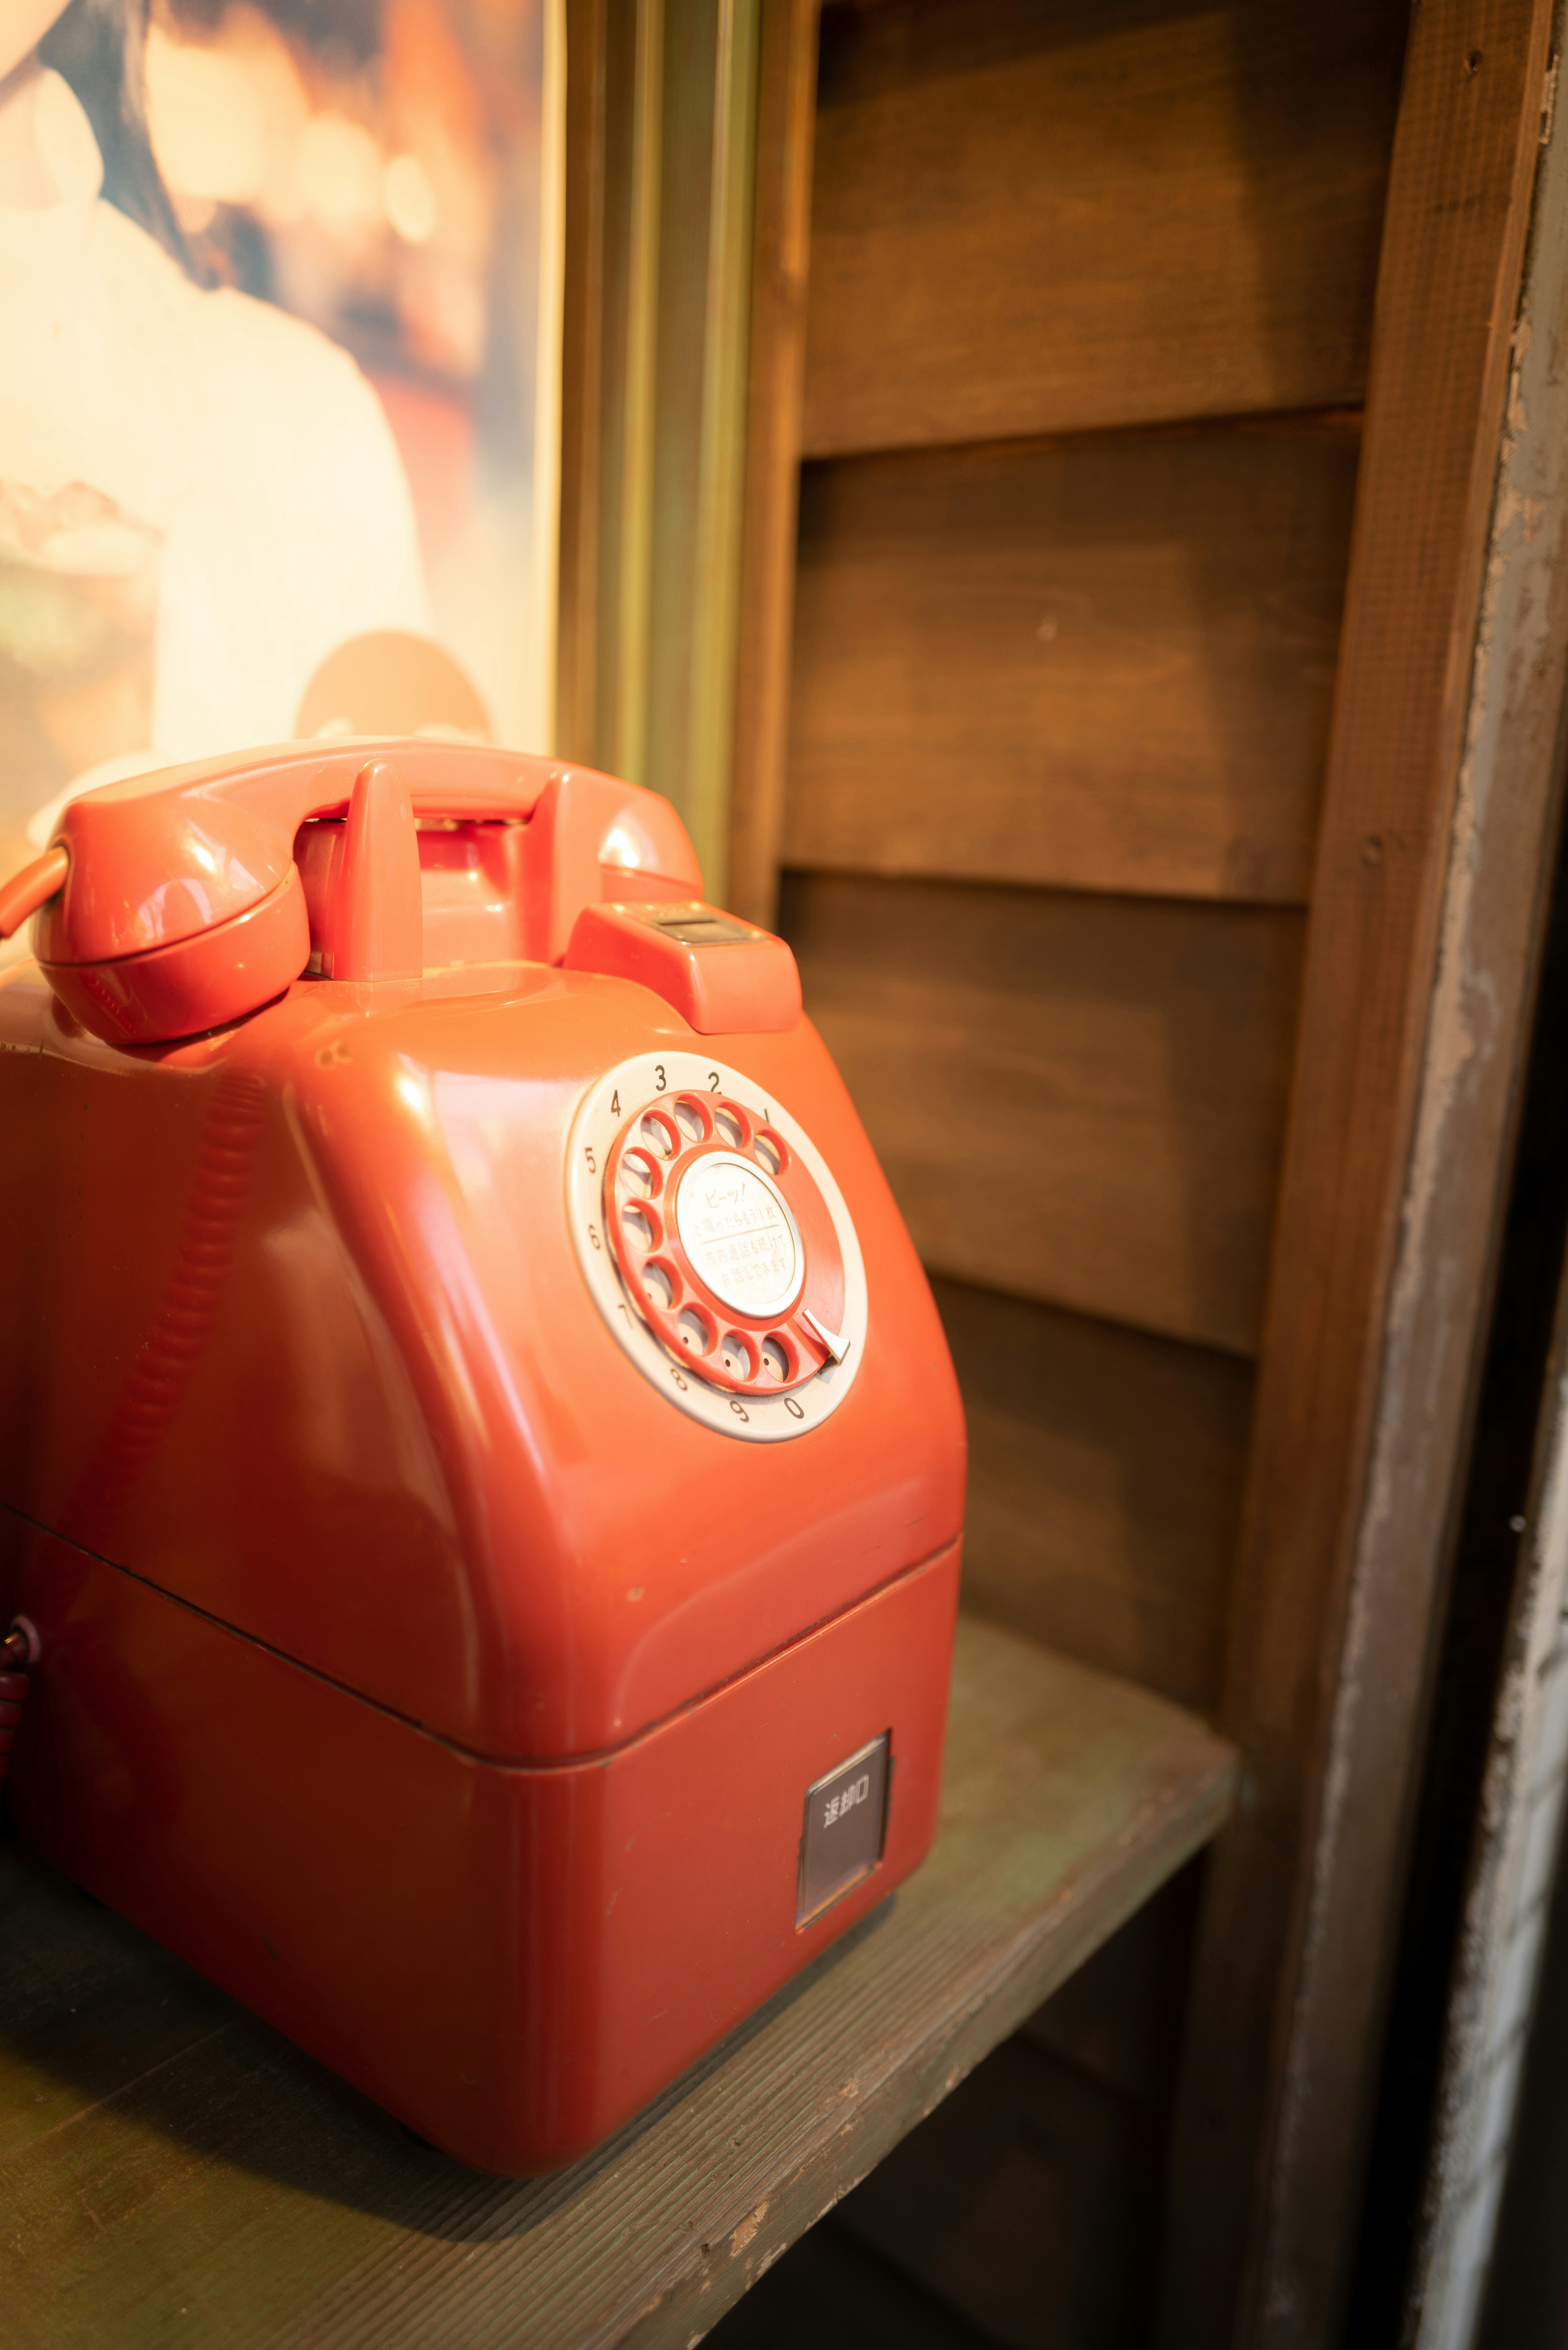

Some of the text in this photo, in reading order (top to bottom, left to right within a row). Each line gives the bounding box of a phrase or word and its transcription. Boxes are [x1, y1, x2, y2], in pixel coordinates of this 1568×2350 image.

[655, 1065, 667, 1091] 3
[708, 1072, 722, 1095] 2
[610, 1089, 621, 1117] 4
[584, 1146, 596, 1174] 5
[588, 1224, 601, 1251] 6
[618, 1304, 633, 1330] 7
[670, 1368, 688, 1391] 8
[729, 1400, 749, 1423] 9
[784, 1397, 804, 1419] 0
[823, 1775, 869, 1828] 返却口
